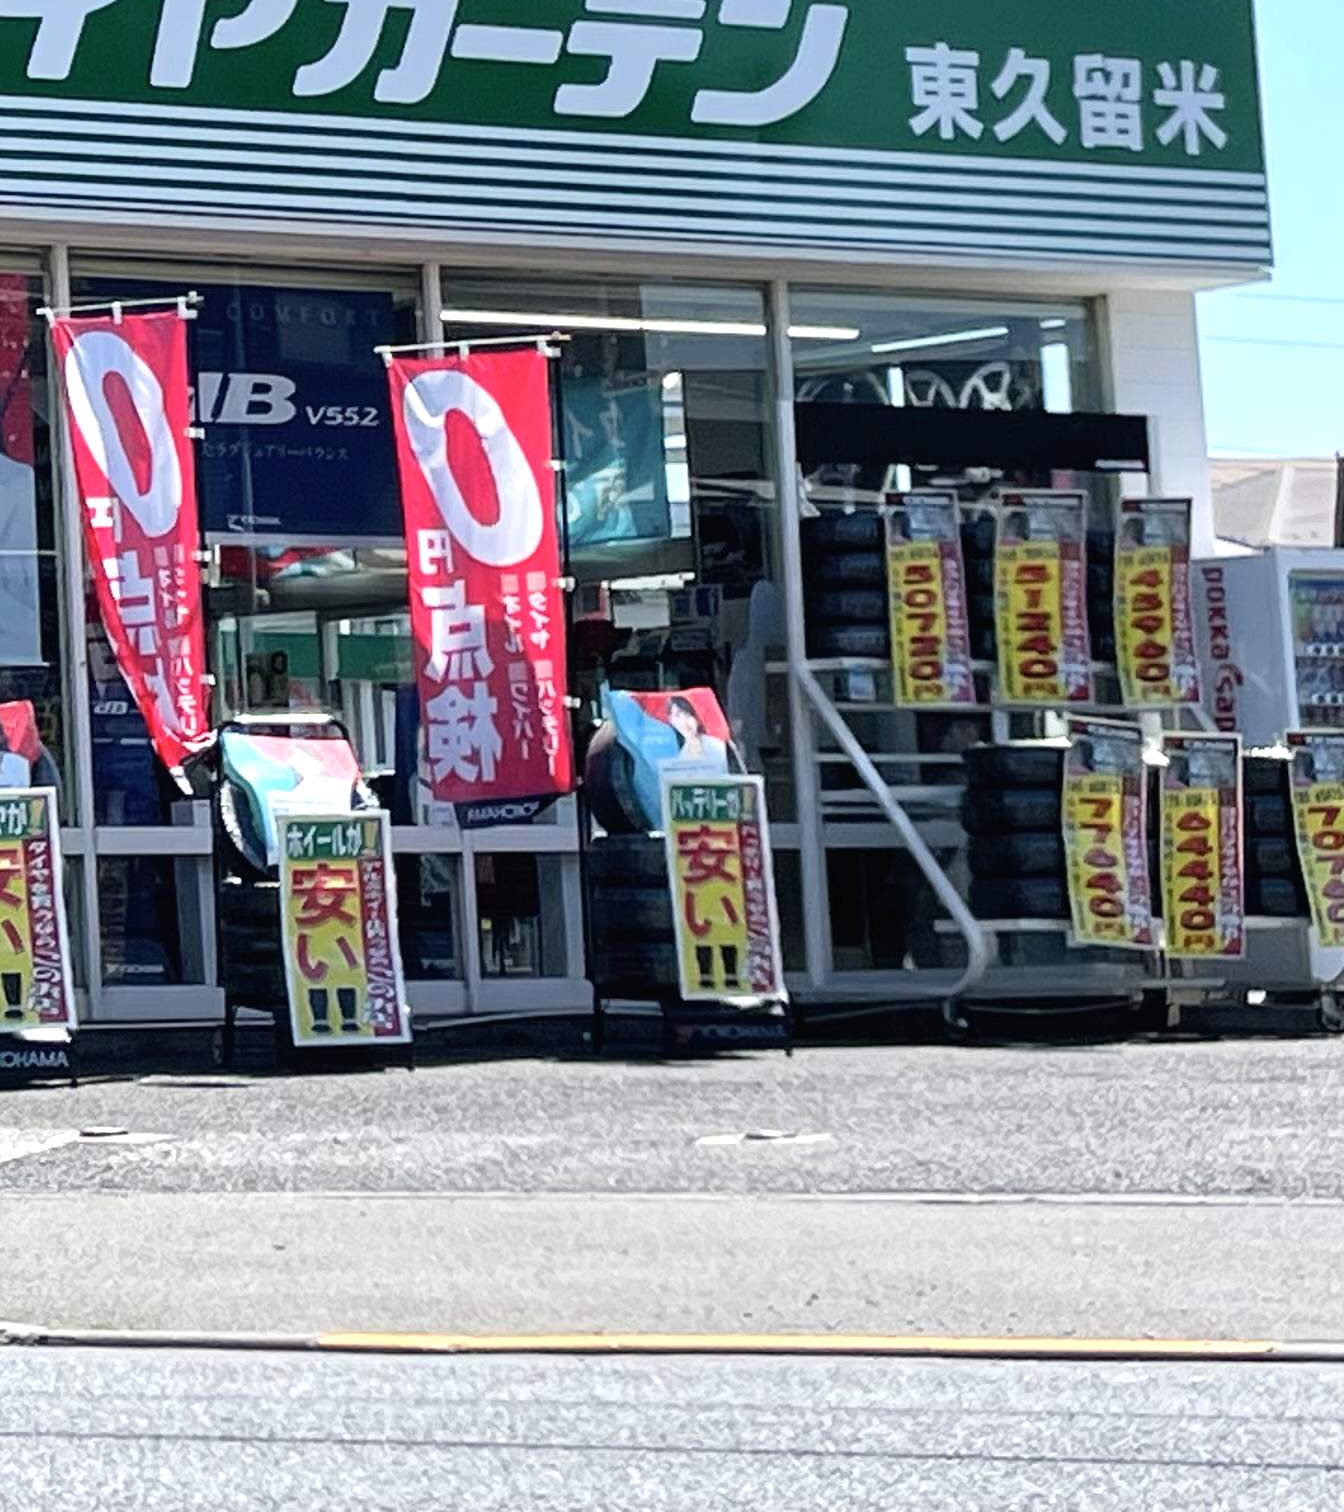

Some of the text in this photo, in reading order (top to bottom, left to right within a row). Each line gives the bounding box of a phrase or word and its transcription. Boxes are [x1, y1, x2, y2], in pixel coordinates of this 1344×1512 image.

[904, 41, 1227, 155] 東久留米
[306, 406, 380, 426] V552
